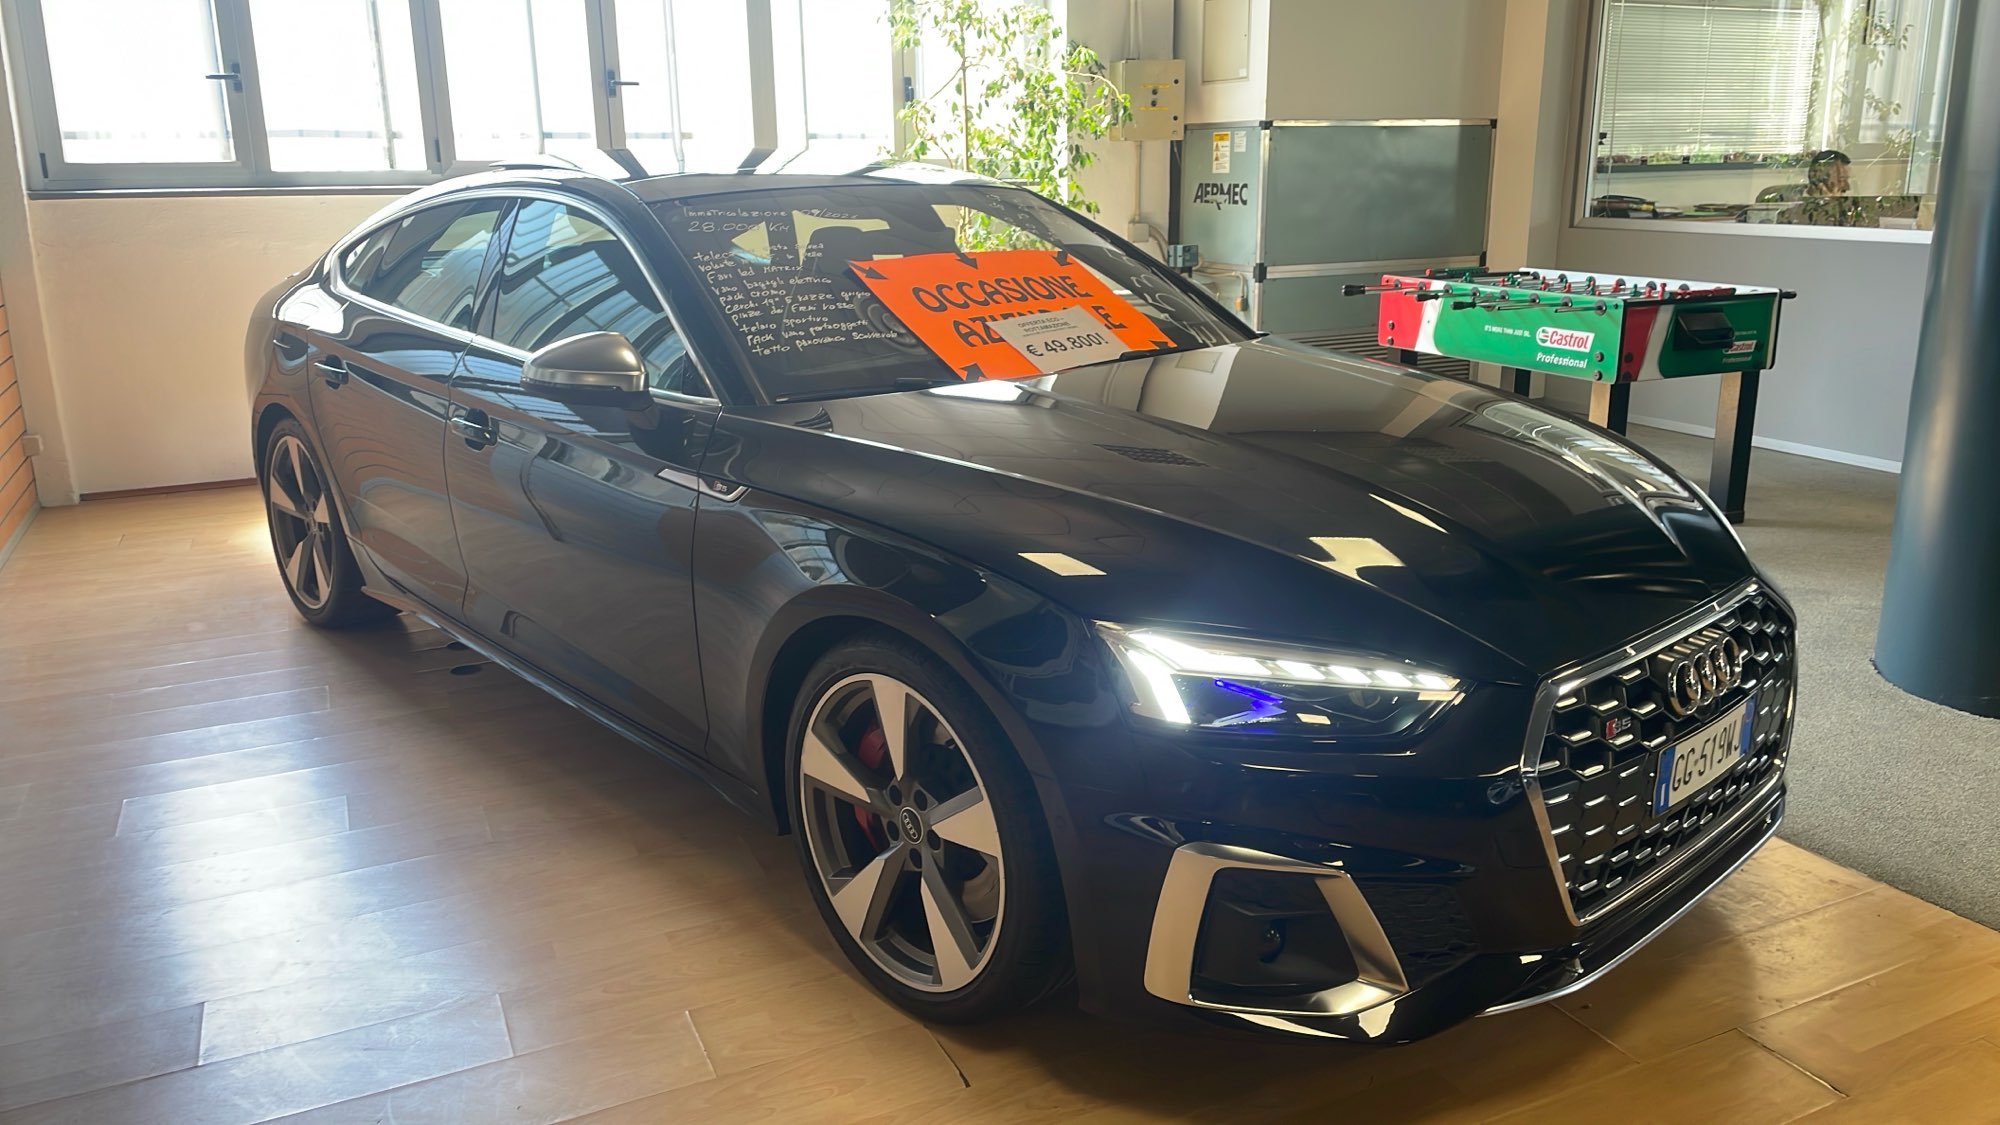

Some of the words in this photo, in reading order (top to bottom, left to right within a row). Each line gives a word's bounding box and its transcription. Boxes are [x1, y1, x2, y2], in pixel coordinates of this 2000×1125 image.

[1193, 183, 1249, 210] AERMEC
[911, 275, 1094, 313] OCCASIONE
[1549, 330, 1590, 349] Castrol
[1536, 352, 1588, 369] Professional
